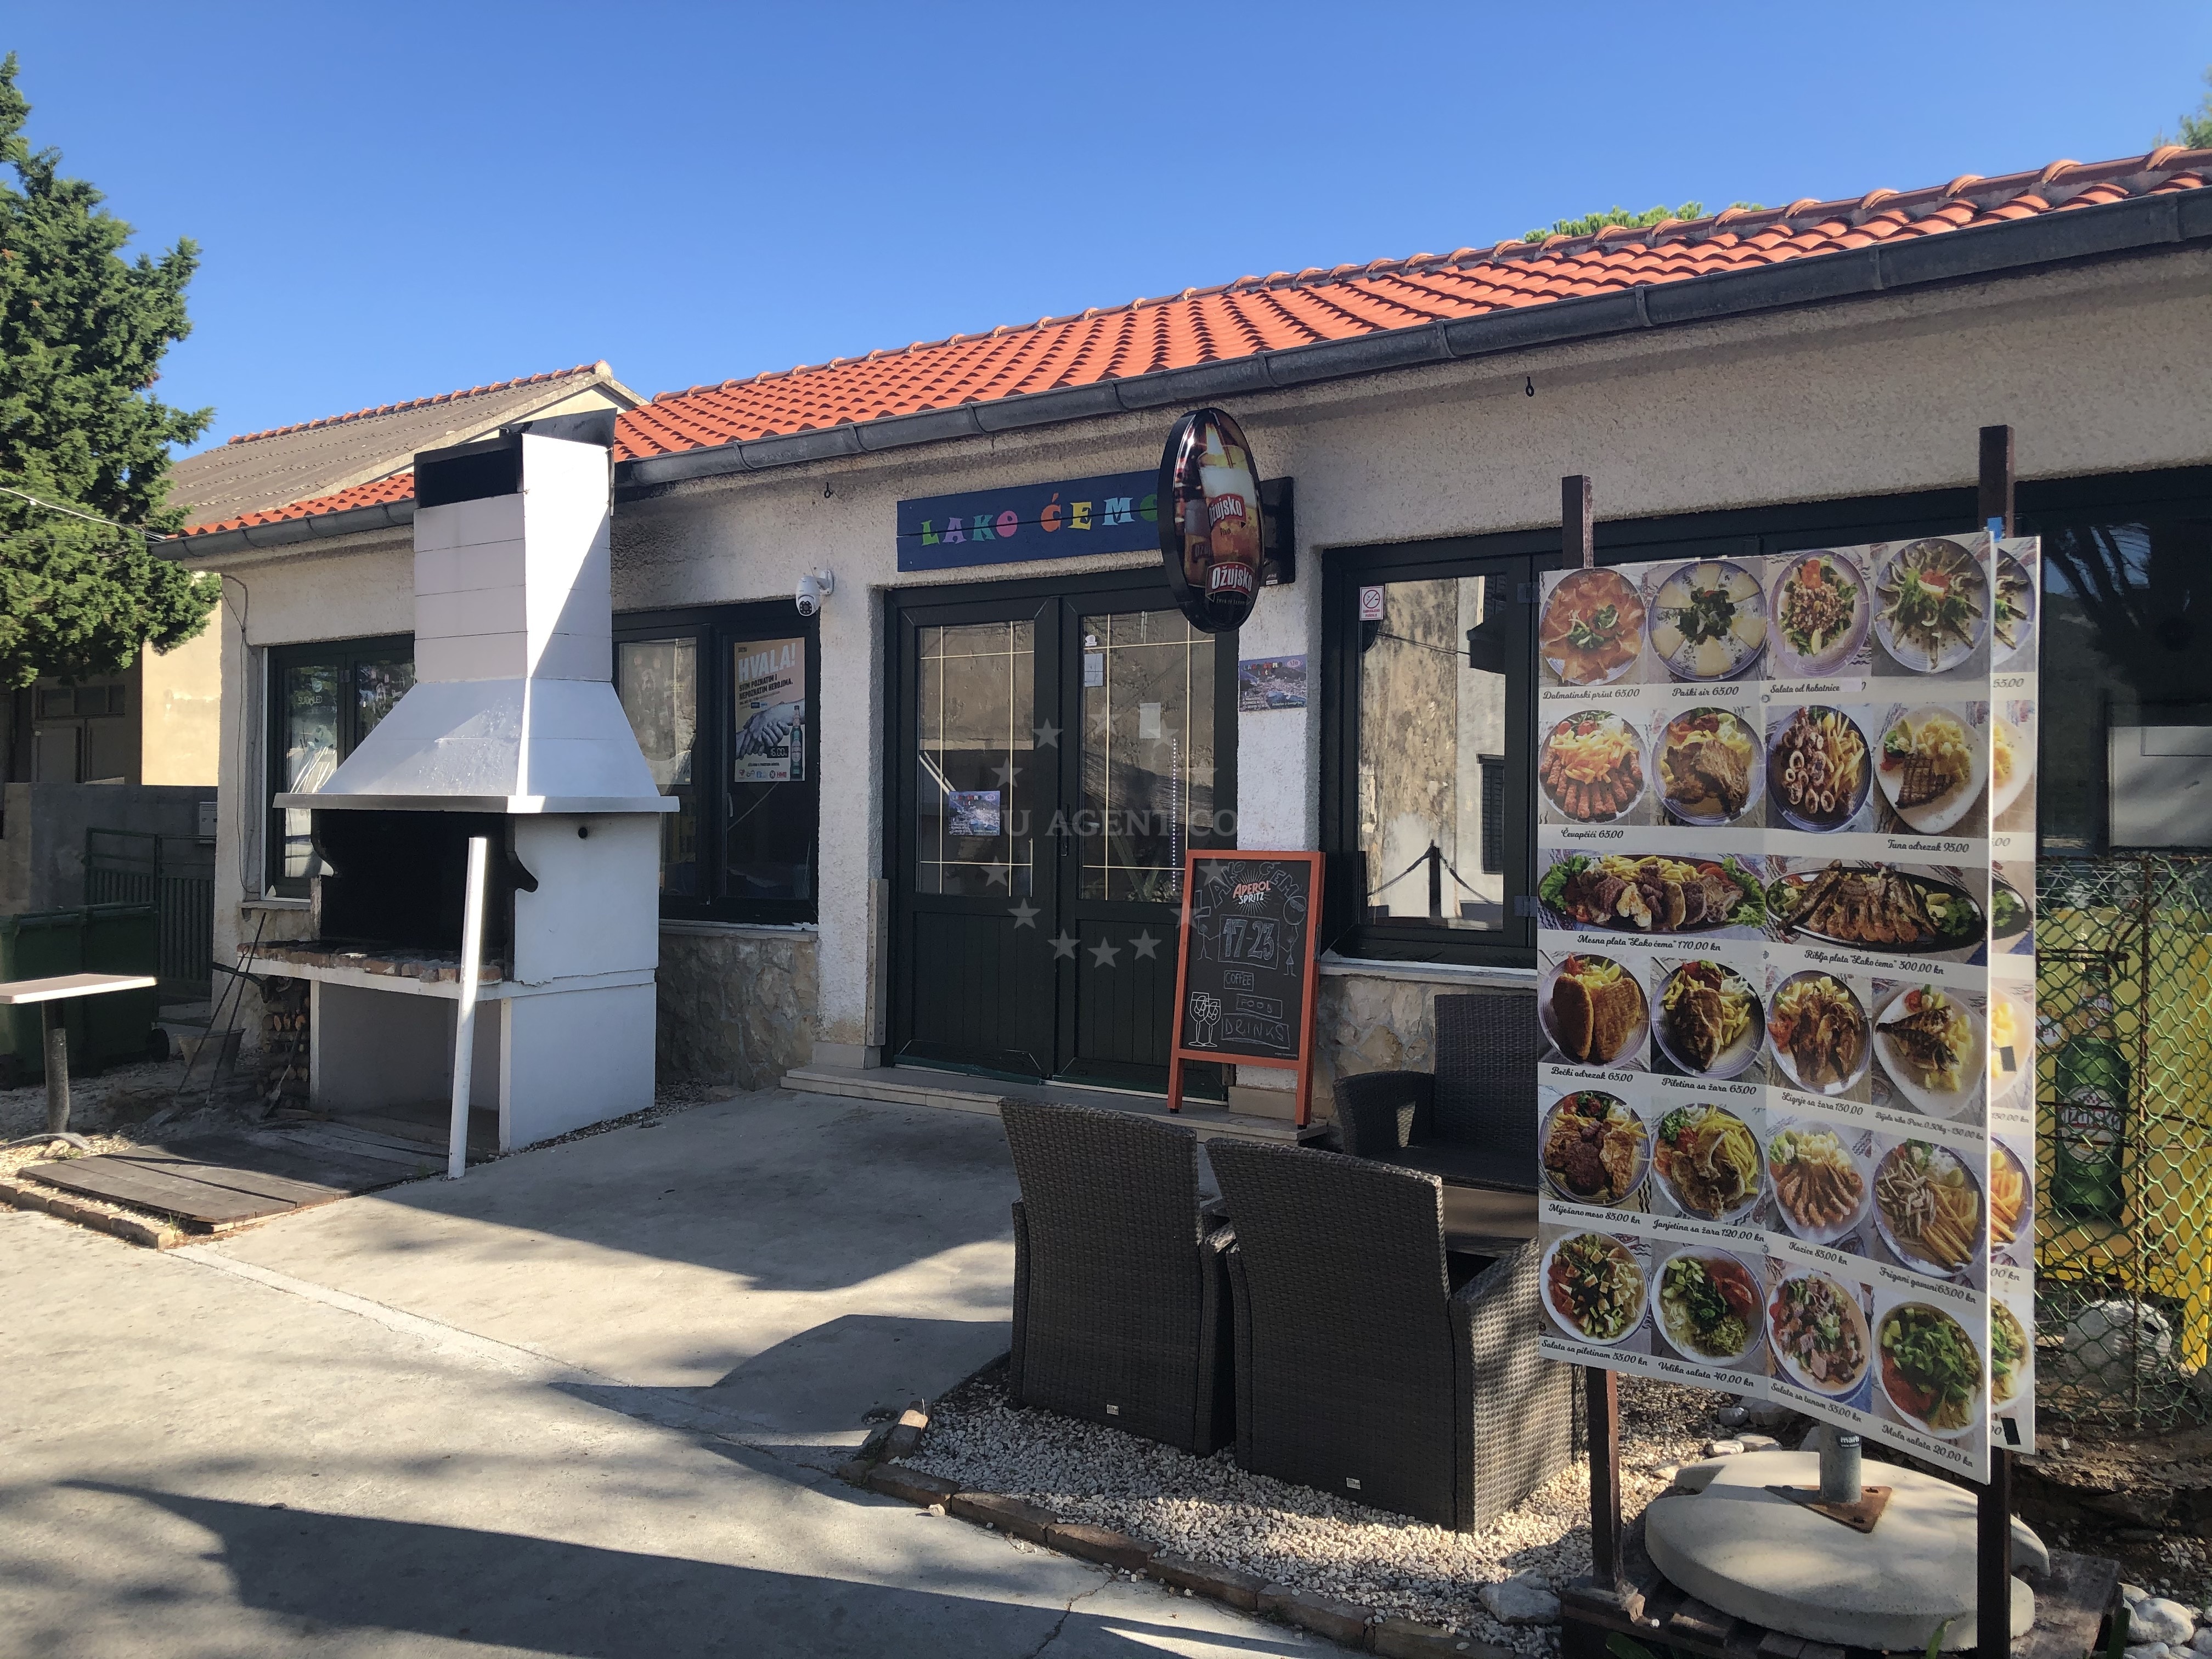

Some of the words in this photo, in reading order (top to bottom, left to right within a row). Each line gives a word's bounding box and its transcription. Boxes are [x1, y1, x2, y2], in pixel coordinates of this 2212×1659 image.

[1209, 496, 1243, 527] Ožujsko
[922, 510, 1018, 546] LAKO
[1211, 565, 1252, 592] Ožujsko
[738, 642, 796, 684] HVALA!
[739, 683, 750, 691] SVIM
[751, 674, 774, 688] POZNATIM
[1770, 684, 1793, 693] Salata
[739, 686, 768, 699] NEPOZNATIM
[1543, 691, 1591, 699] Dalmatinski
[1592, 690, 1612, 700] pršut
[1615, 689, 1640, 698] 65,00
[1672, 688, 1697, 697] Paški
[1698, 688, 1709, 696] sir
[1712, 686, 1739, 696] 65,00
[1599, 830, 1623, 839] 65,00
[1888, 839, 1906, 849] Tuna
[1909, 841, 1941, 851] odrezak
[1943, 842, 1970, 853] 95,00
[1232, 881, 1272, 899] APEROL
[1238, 891, 1265, 905] SPRITZ
[1577, 935, 1605, 944] Mesna
[1606, 937, 1626, 947] plata
[1804, 950, 1828, 963] Riblja
[1829, 953, 1848, 963] plata
[1933, 964, 1944, 975] kn
[1225, 973, 1252, 986] COFFEE
[1241, 999, 1273, 1014] FOOD
[1225, 1018, 1284, 1042] DRINKS
[1550, 1066, 1573, 1076] Bečki
[1575, 1070, 1606, 1080] odrezak
[1607, 1072, 1633, 1082] 65,00
[1661, 1078, 1695, 1090] Piletina
[1708, 1083, 1728, 1093] žara
[1729, 1085, 1757, 1096] 65,00
[1781, 1092, 1806, 1107] Lignje
[1807, 1099, 1815, 1107] sa
[1817, 1100, 1834, 1111] žara
[1548, 1203, 1584, 1216] Miješano
[1605, 1211, 1629, 1222] 85,00
[1630, 1215, 1641, 1224] kn
[1652, 1218, 1689, 1231] Janjetina
[1701, 1227, 1720, 1236] žara
[1754, 1233, 1764, 1243] kn
[1815, 1249, 1837, 1262] 85,00
[1838, 1255, 1848, 1266] kn
[1965, 1293, 1976, 1304] kn
[1541, 1339, 1566, 1351] Salata
[1638, 1357, 1648, 1367] kn
[1658, 1361, 1685, 1375] Velika
[1686, 1366, 1712, 1379] salata
[1743, 1378, 1754, 1387] kn
[1770, 1383, 1794, 1398] Salata
[1882, 1424, 1905, 1441] Mala
[1906, 1436, 1932, 1451] salata
[1962, 1456, 1974, 1468] kn
